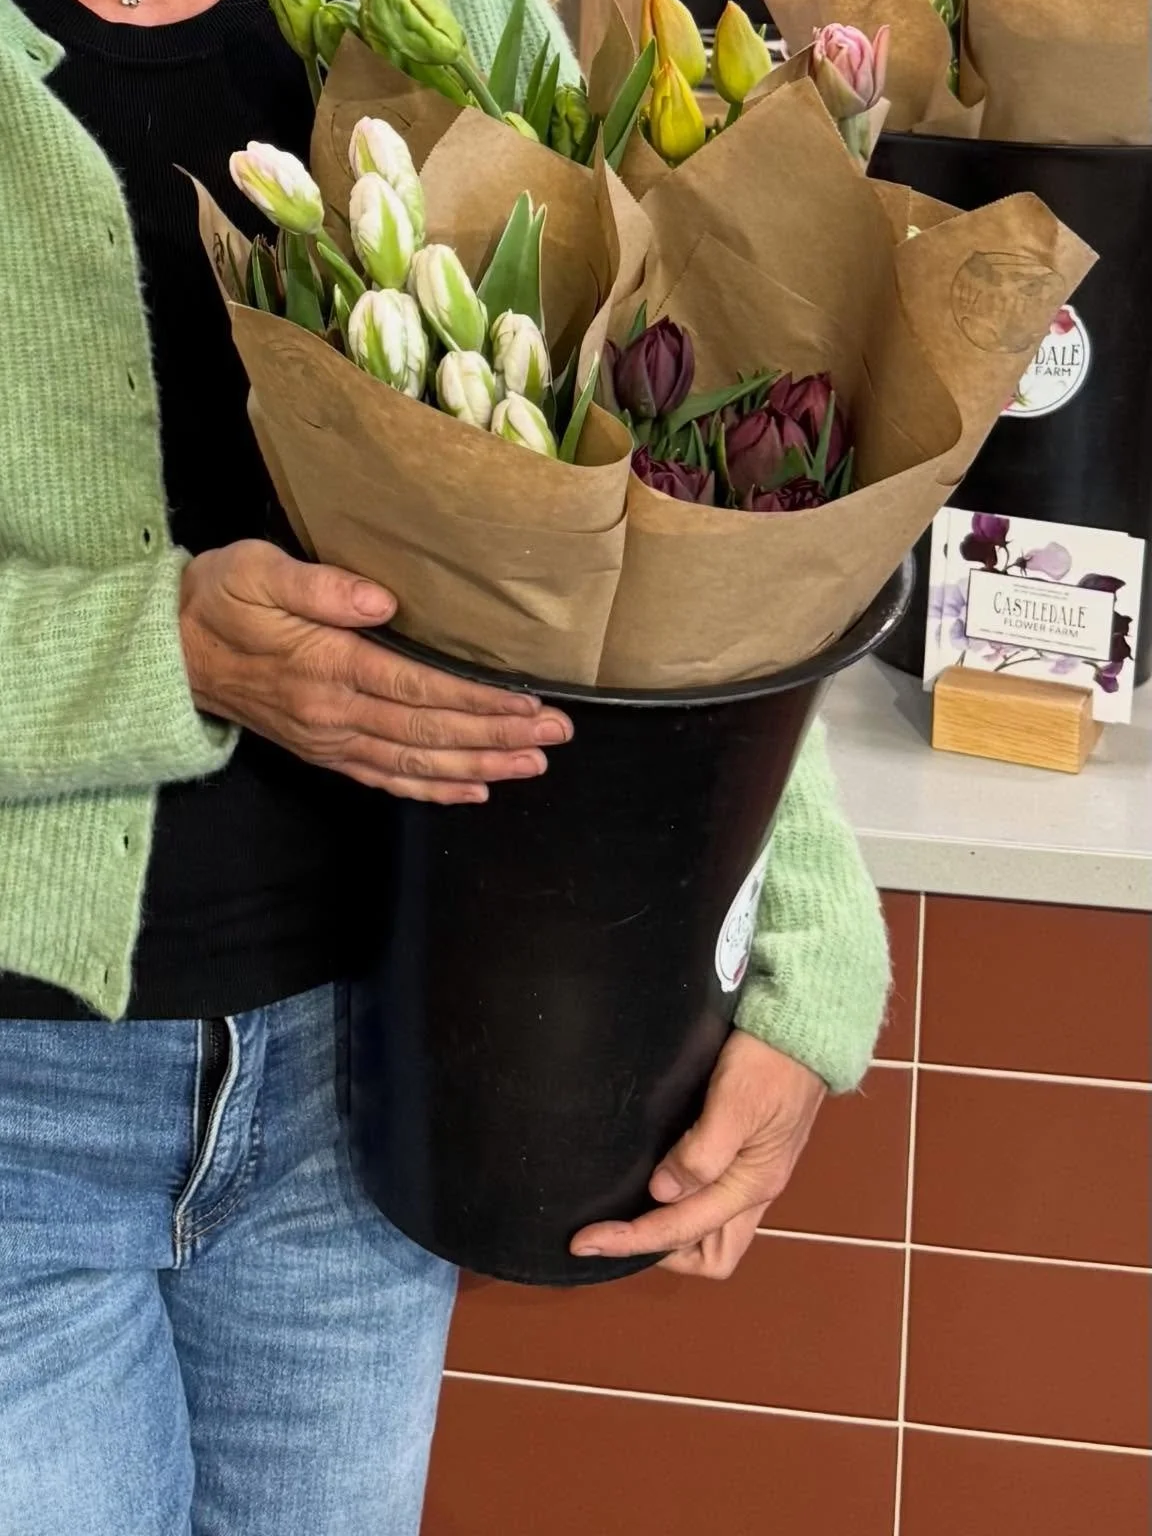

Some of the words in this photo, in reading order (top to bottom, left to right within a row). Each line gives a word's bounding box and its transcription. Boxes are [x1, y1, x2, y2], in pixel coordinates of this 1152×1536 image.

[1035, 366, 1072, 377] FARM
[993, 591, 1089, 629] CASTLEDALE
[1003, 616, 1046, 633] FLOWER
[1048, 625, 1079, 639] FARM
